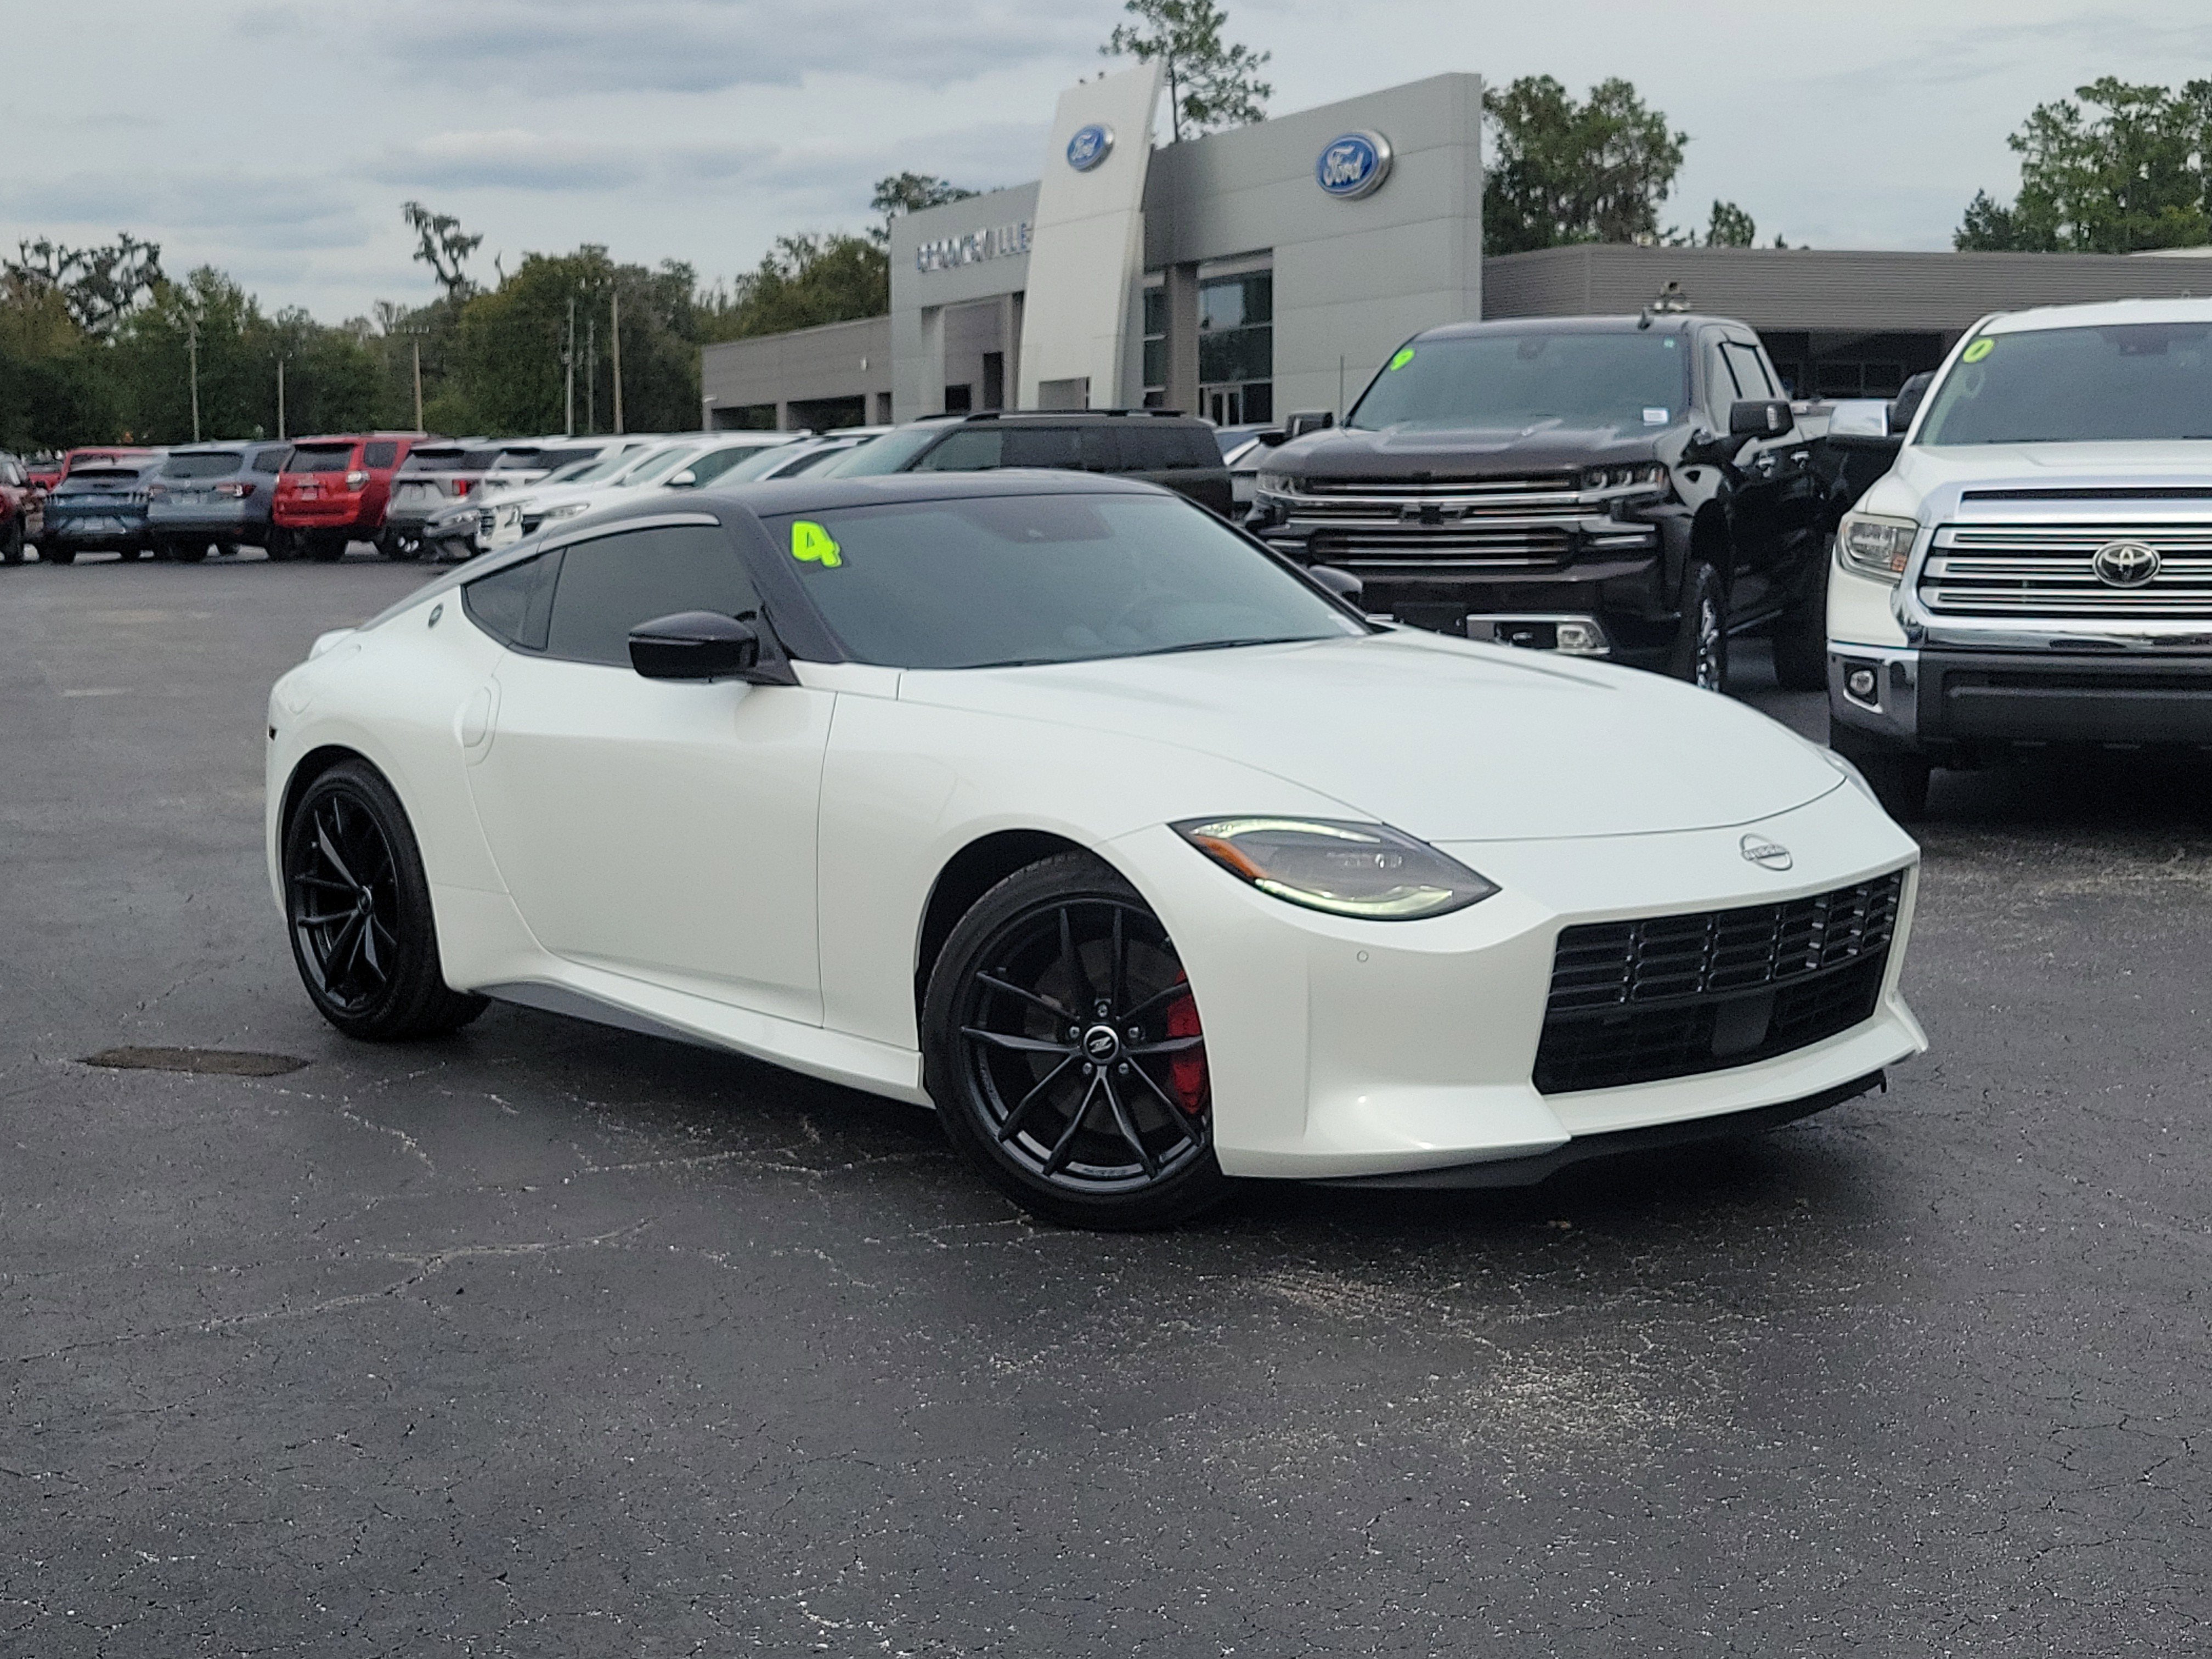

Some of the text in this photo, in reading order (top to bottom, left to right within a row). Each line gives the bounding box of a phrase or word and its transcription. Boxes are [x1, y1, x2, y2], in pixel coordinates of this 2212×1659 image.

[1070, 134, 1097, 160] Ford
[1323, 145, 1364, 187] Ford
[791, 520, 843, 568] 4
